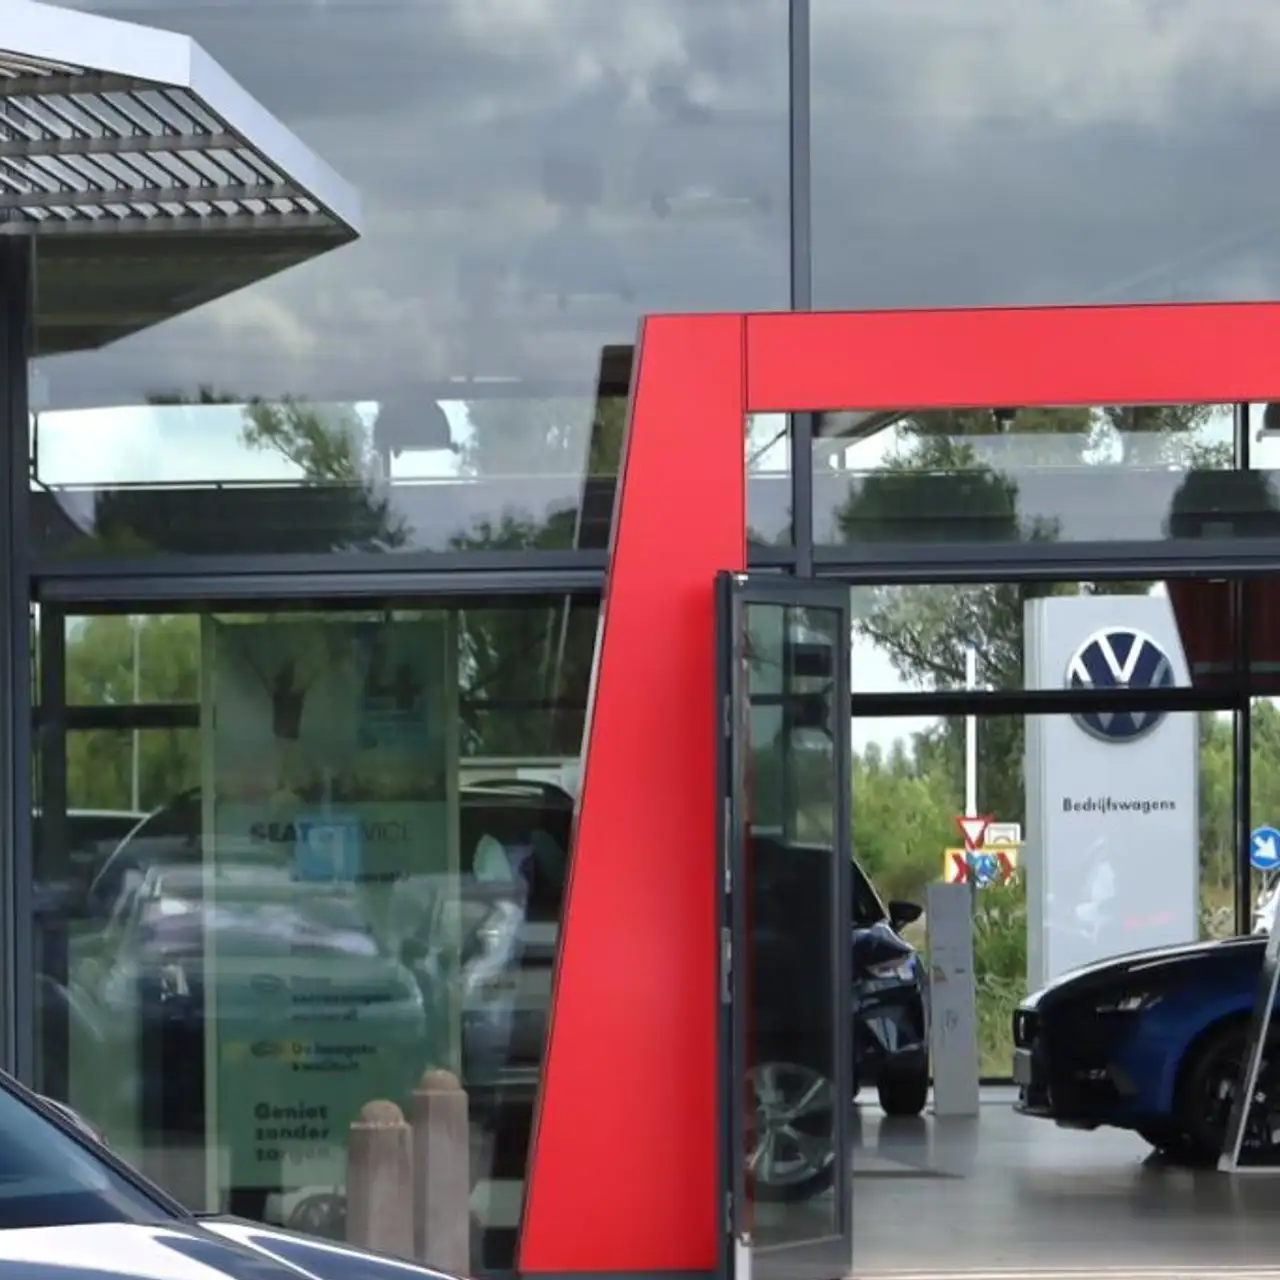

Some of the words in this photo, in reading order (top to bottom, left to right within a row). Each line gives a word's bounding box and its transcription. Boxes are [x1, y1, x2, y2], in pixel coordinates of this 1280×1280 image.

[1062, 796, 1177, 814] Bedrijfswagens
[249, 821, 314, 844] SEAT
[253, 1101, 328, 1120] Geniet
[255, 1124, 330, 1141] zonder
